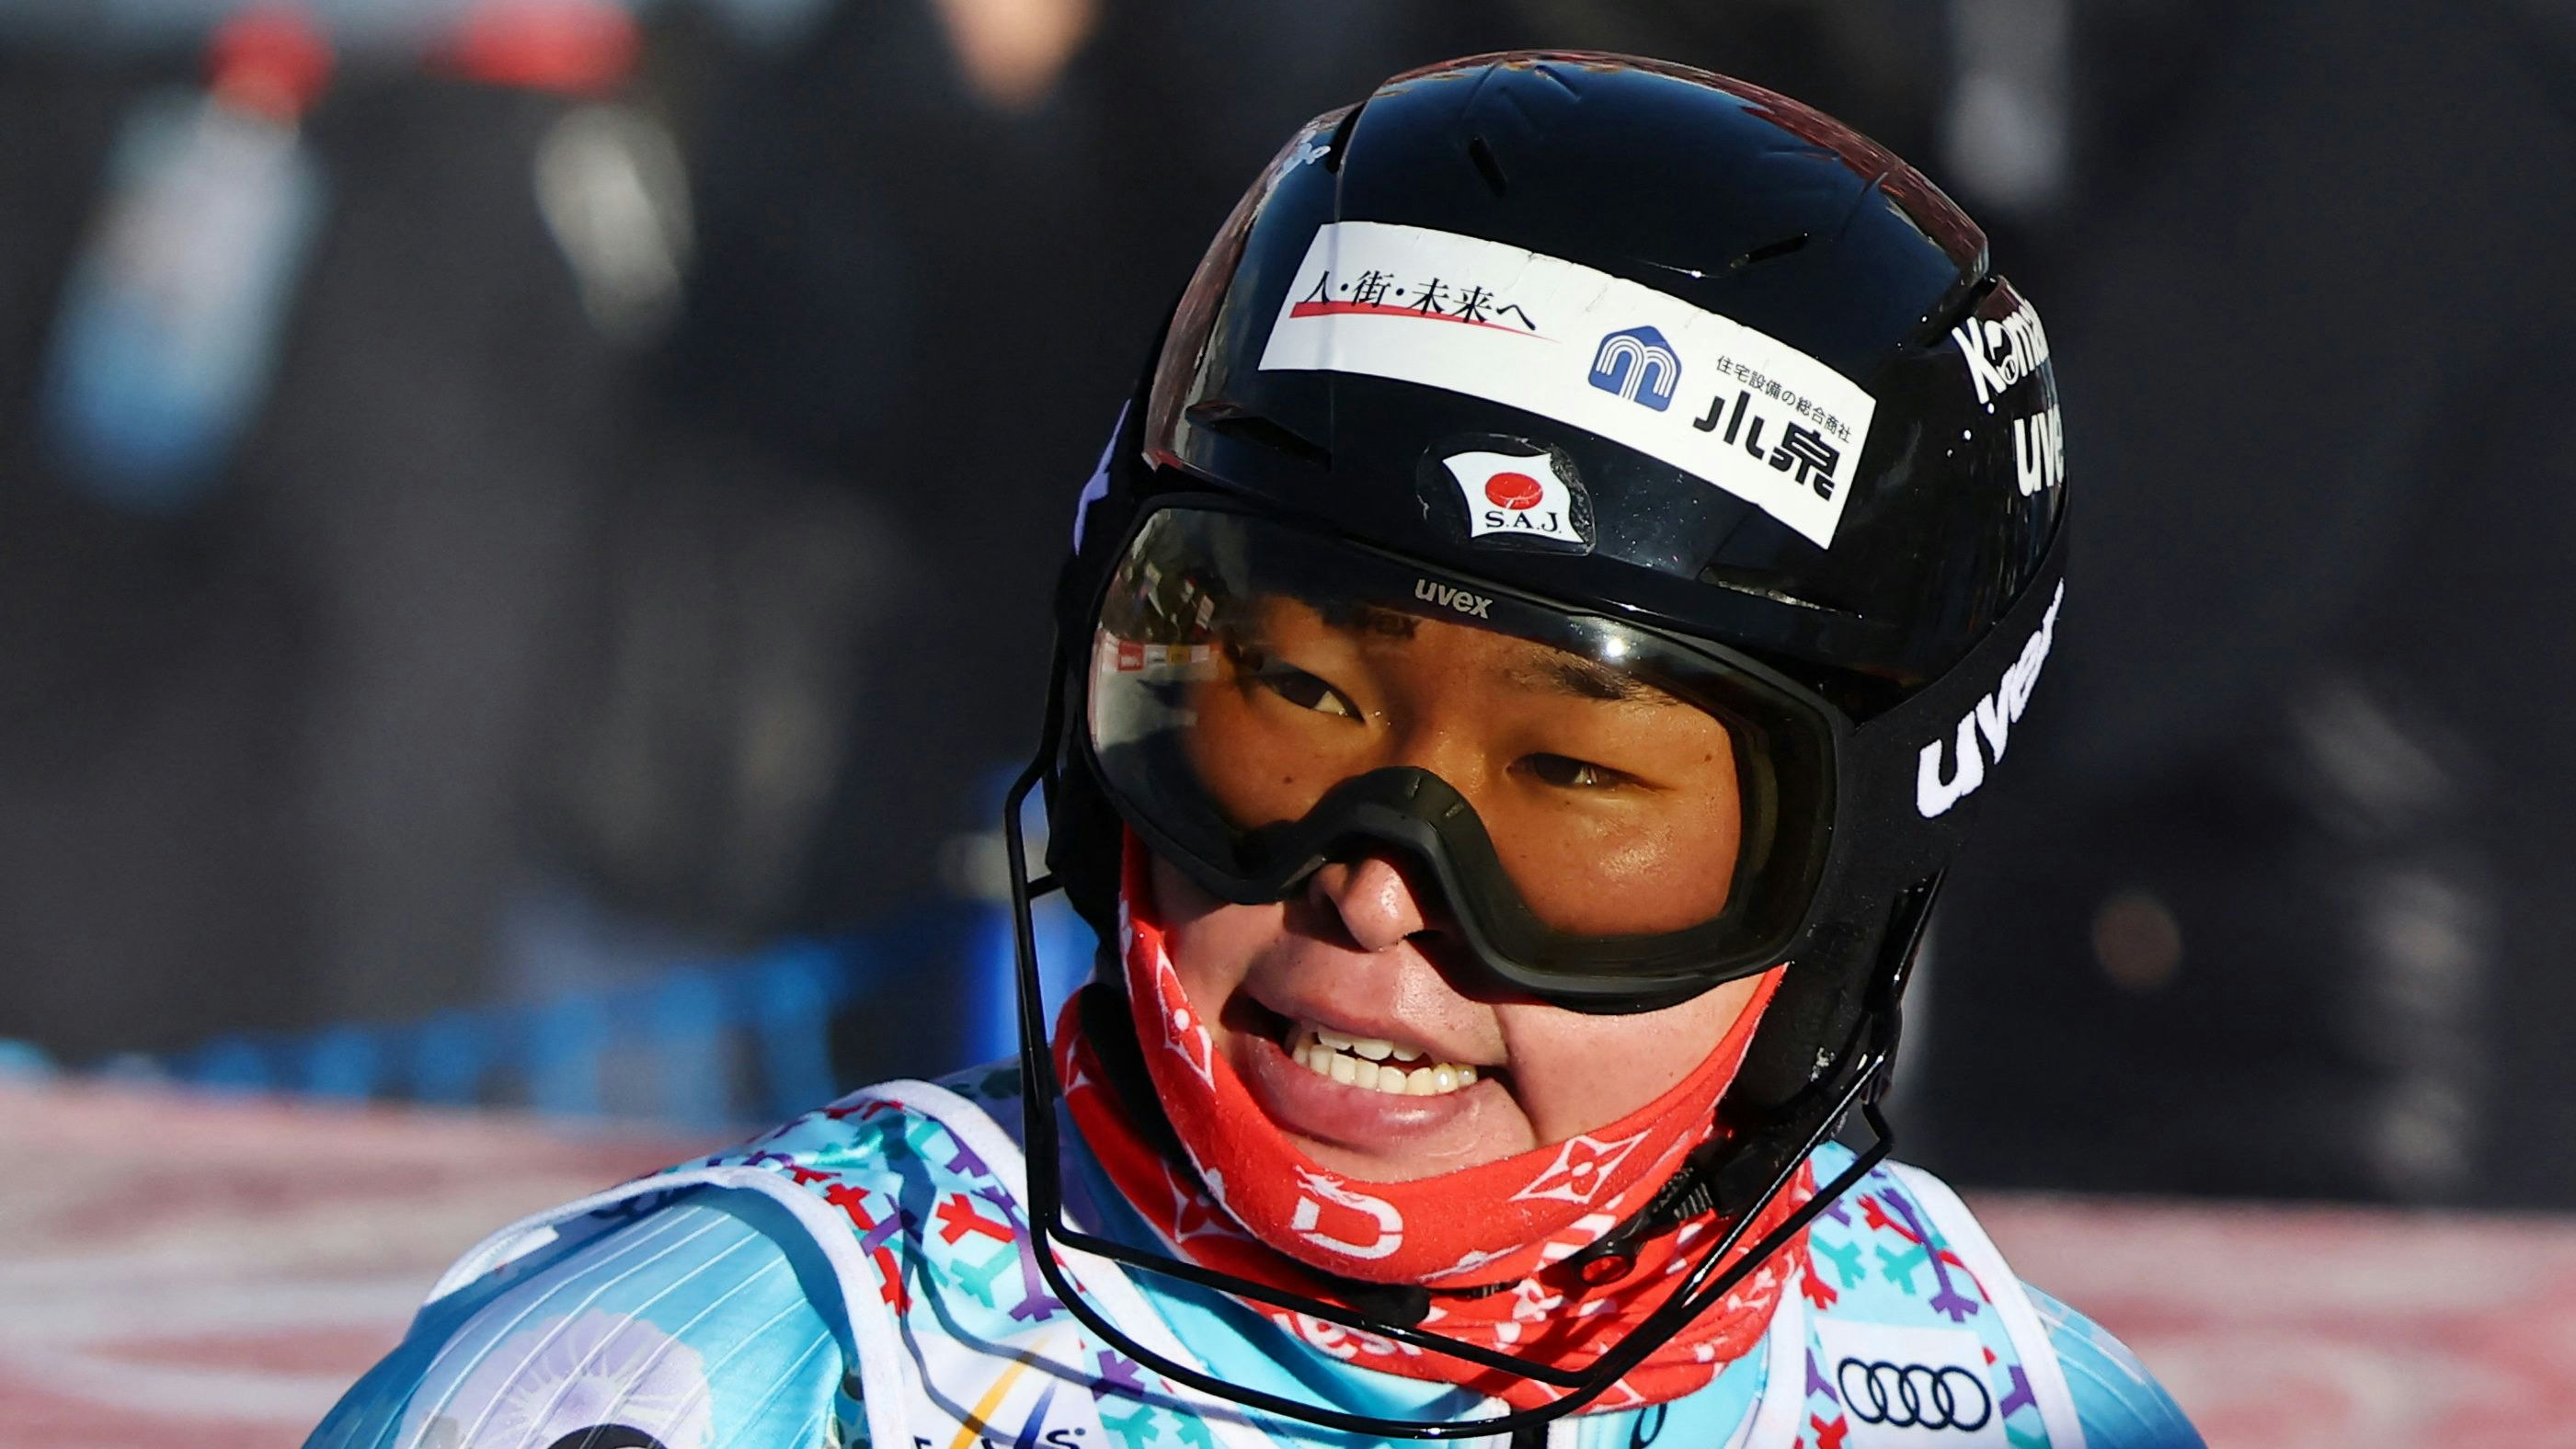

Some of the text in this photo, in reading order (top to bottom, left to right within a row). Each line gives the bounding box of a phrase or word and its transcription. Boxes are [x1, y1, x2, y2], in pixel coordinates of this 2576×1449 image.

[1716, 355, 1851, 444] 住宅設備の総合商社
[1692, 390, 1840, 501] 小泉
[1484, 510, 1562, 533] S.A.J.
[1414, 578, 1493, 620] uvex
